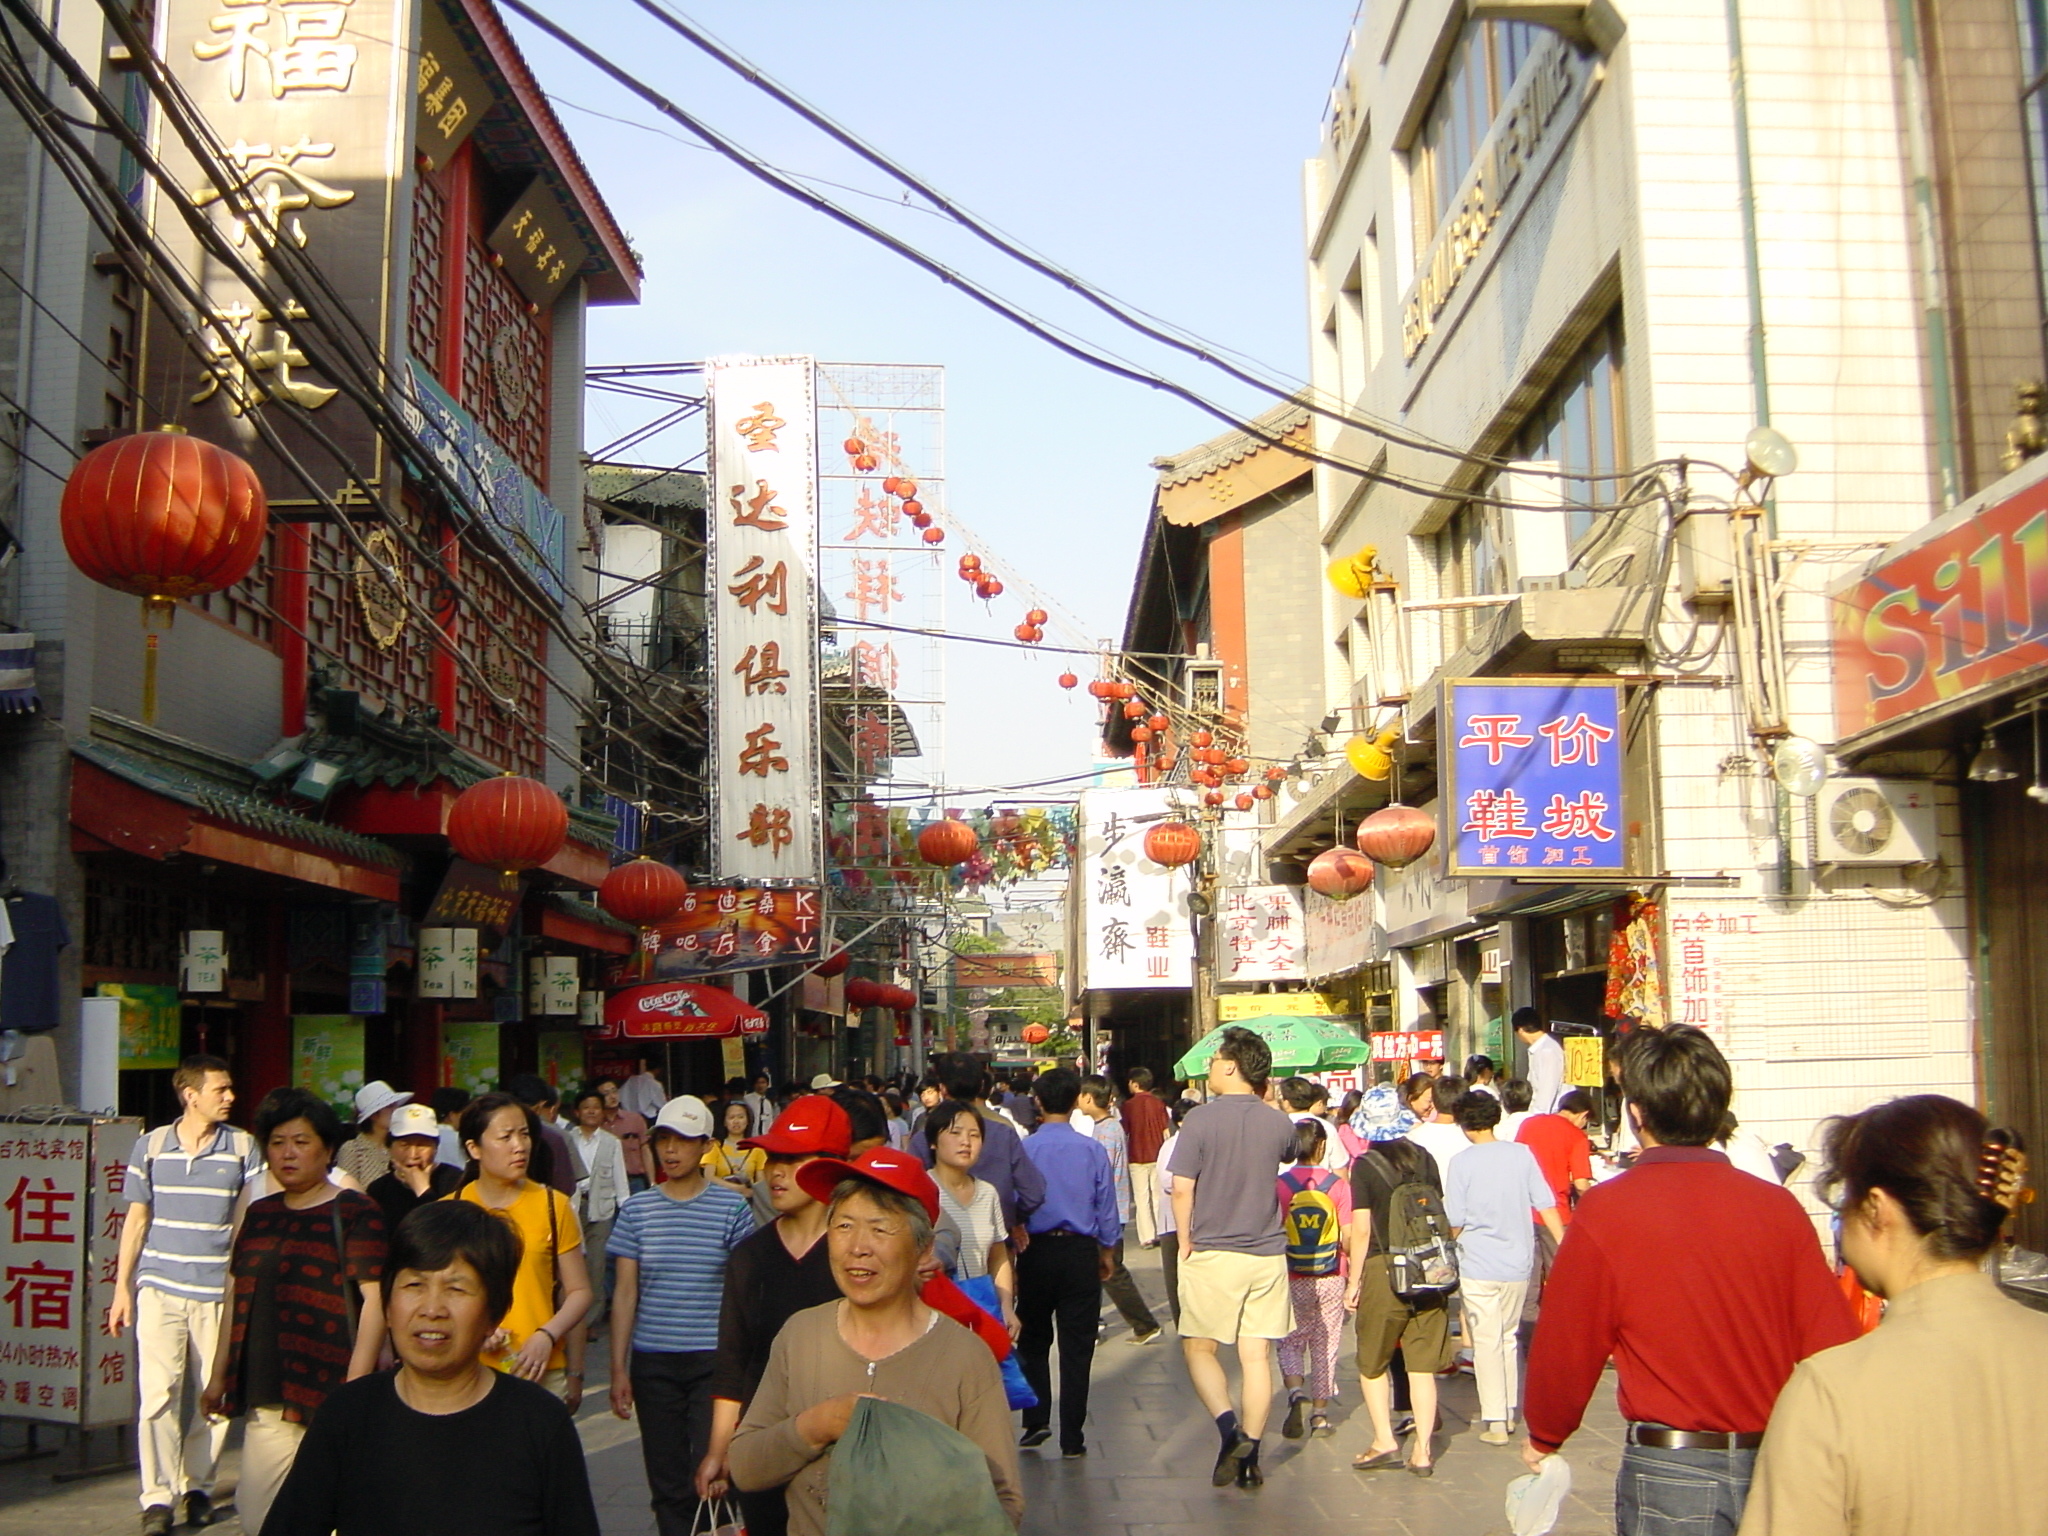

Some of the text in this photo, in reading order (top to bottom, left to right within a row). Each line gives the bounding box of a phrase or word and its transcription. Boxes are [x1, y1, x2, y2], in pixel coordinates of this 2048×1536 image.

[728, 401, 795, 860] 圣达利俱乐部
[1459, 712, 1614, 768] 平价
[1461, 788, 1616, 843] 鞋城
[1477, 845, 1593, 866] 首饰加工
[717, 889, 738, 956] 迪厅
[755, 890, 778, 957] 桑拿
[795, 890, 815, 955] KTV
[1145, 926, 1170, 978] 鞋业
[1228, 894, 1258, 972] 北京特产
[1264, 894, 1295, 972] 果脯大全
[421, 946, 446, 971] 茶
[423, 980, 443, 989] Tea
[551, 971, 575, 993] 茶
[1680, 936, 1710, 1029] 首饰加
[1299, 1213, 1320, 1229] M
[3, 1175, 75, 1330] 住宿
